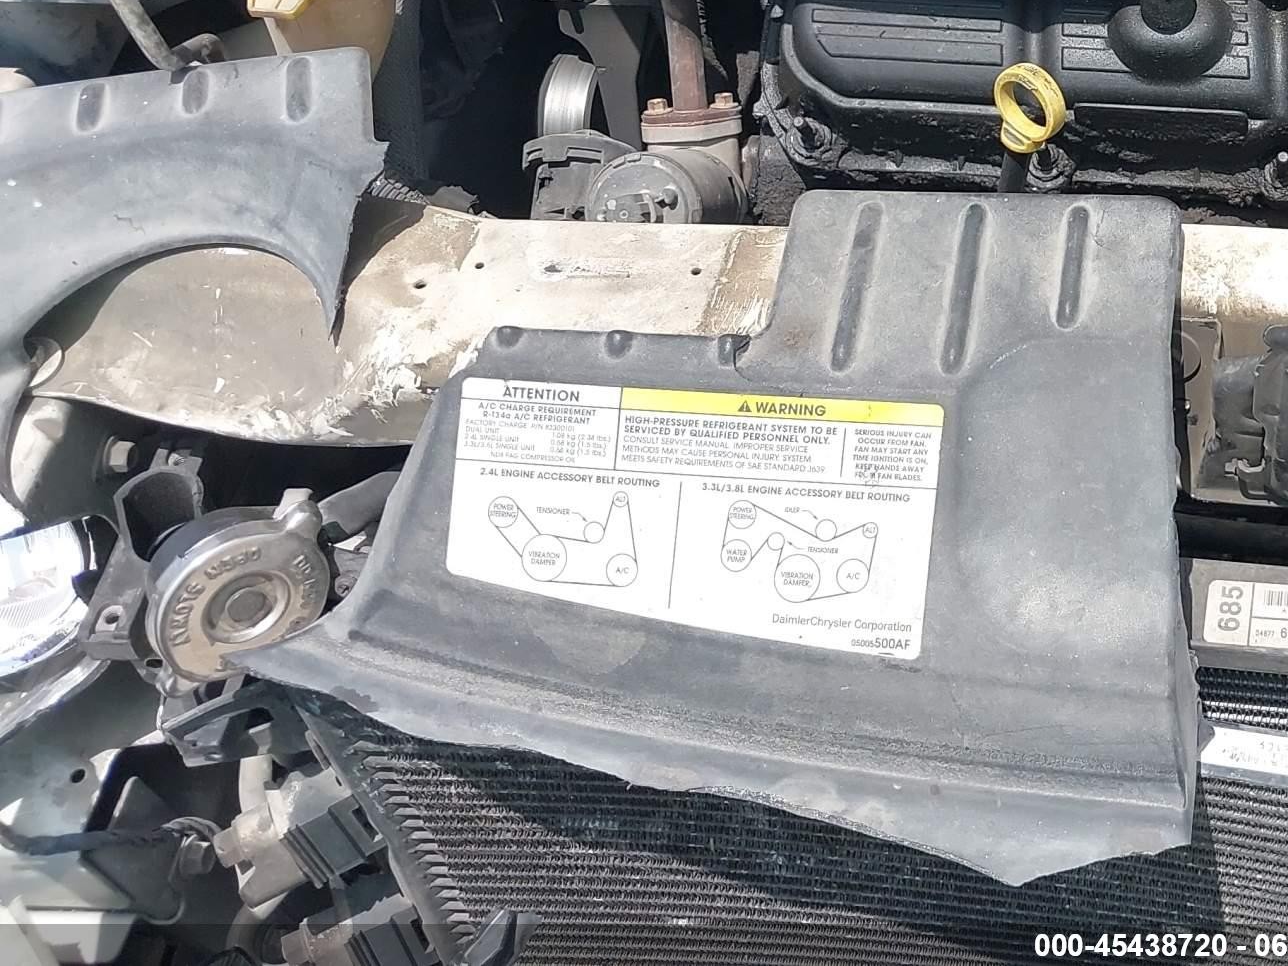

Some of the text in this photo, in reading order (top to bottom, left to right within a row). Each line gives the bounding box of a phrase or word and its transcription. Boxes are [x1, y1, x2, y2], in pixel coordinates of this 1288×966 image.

[503, 386, 579, 401] ATTENTION
[499, 403, 534, 412] CHARGE
[537, 406, 595, 416] REQUIREMENT
[755, 401, 825, 416] WARNING
[498, 421, 527, 429] CHARGE
[533, 414, 589, 424] REFRIGERANT
[624, 416, 698, 428] HIGH-PRESSURE
[702, 420, 766, 432] REFRIGERANT
[770, 424, 806, 434] SYSTEM
[624, 425, 670, 436] SERVICED
[689, 428, 739, 440] QUALIFIED
[742, 431, 798, 443] PERSONNEL
[802, 434, 830, 445] ONLY.
[782, 453, 811, 463] SYSTEM
[480, 468, 659, 487] 2.4L ENGINE ACCESSORY BELT ROUTING
[702, 483, 909, 503] 3.3L/3.8L ENGINE ACCESSORY BELT ROUTING
[536, 507, 570, 515] TENSIONER
[865, 526, 876, 534] ALT
[529, 551, 560, 559] VIBRATION
[616, 566, 629, 574] A/C
[847, 572, 859, 580] A/C
[1218, 586, 1244, 631] 685
[772, 614, 911, 632] DaimlerChrysler Corporation
